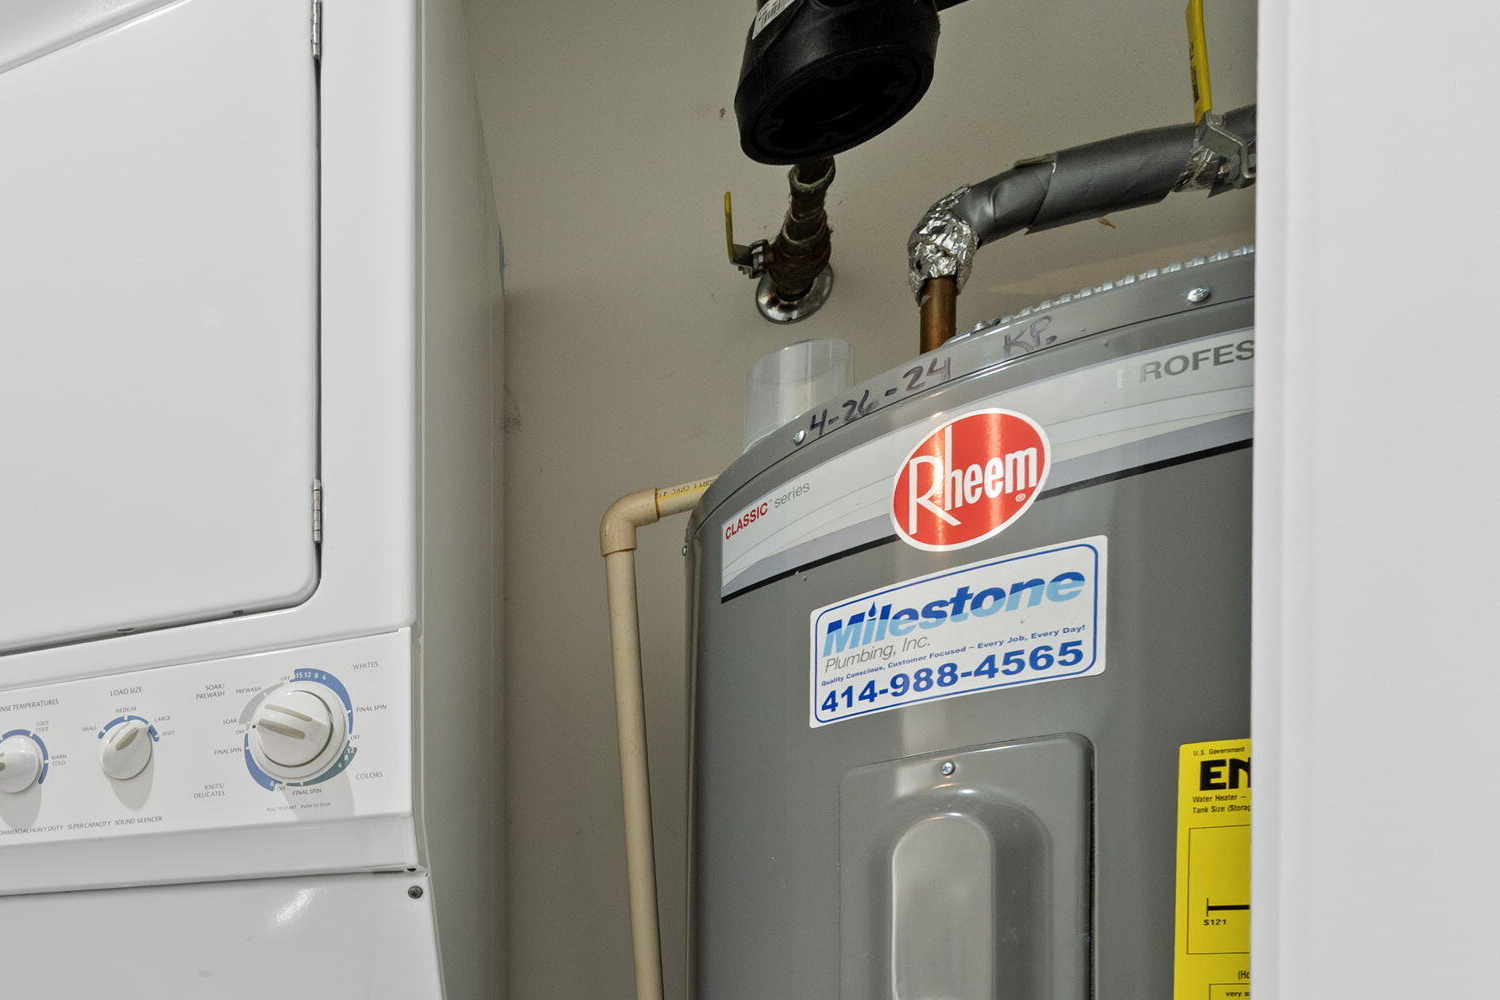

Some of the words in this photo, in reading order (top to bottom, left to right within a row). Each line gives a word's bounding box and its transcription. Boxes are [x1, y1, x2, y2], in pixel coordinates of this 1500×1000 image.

[809, 357, 951, 435] 4-26-24
[909, 425, 1037, 535] Rheem
[725, 501, 769, 540] CLASSIC
[774, 482, 810, 509] series
[822, 571, 1086, 658] Milestone
[821, 676, 844, 687] Quality
[846, 666, 886, 680] Conscious,
[888, 656, 927, 669] Customer
[929, 646, 966, 660] Focused
[978, 639, 1004, 649] Every
[1007, 635, 1028, 644] Job,
[1031, 630, 1060, 640] Every
[1062, 624, 1086, 635] Day!
[825, 645, 896, 673] Plumbing,
[902, 636, 931, 653] Inc.
[352, 661, 379, 671] WHITES
[821, 640, 1084, 712] 414-988-4565
[110, 688, 129, 697] LOAD
[129, 686, 142, 694] SIZE
[205, 683, 225, 691] SOAK/
[236, 686, 262, 695] PREWASH
[196, 690, 225, 700] PREWASH
[12, 699, 59, 711] TEMPERATURES
[356, 705, 373, 713] FINAL
[115, 706, 137, 714] MEDIUM
[154, 715, 171, 723] LARGE
[222, 717, 237, 726] SOAK
[214, 748, 231, 756] FINAL
[1208, 746, 1245, 755] Government
[355, 772, 383, 780] COLORS
[193, 790, 226, 799] DELICATES
[292, 788, 310, 796] FINAL
[1215, 794, 1238, 802] Heater
[1193, 806, 1208, 814] Tank
[1211, 805, 1225, 813] Size
[29, 826, 47, 834] HEAVY
[67, 822, 84, 830] SUPER
[84, 820, 111, 829] CAPACITY
[137, 816, 162, 824] SILENCER
[1226, 990, 1242, 998] very
